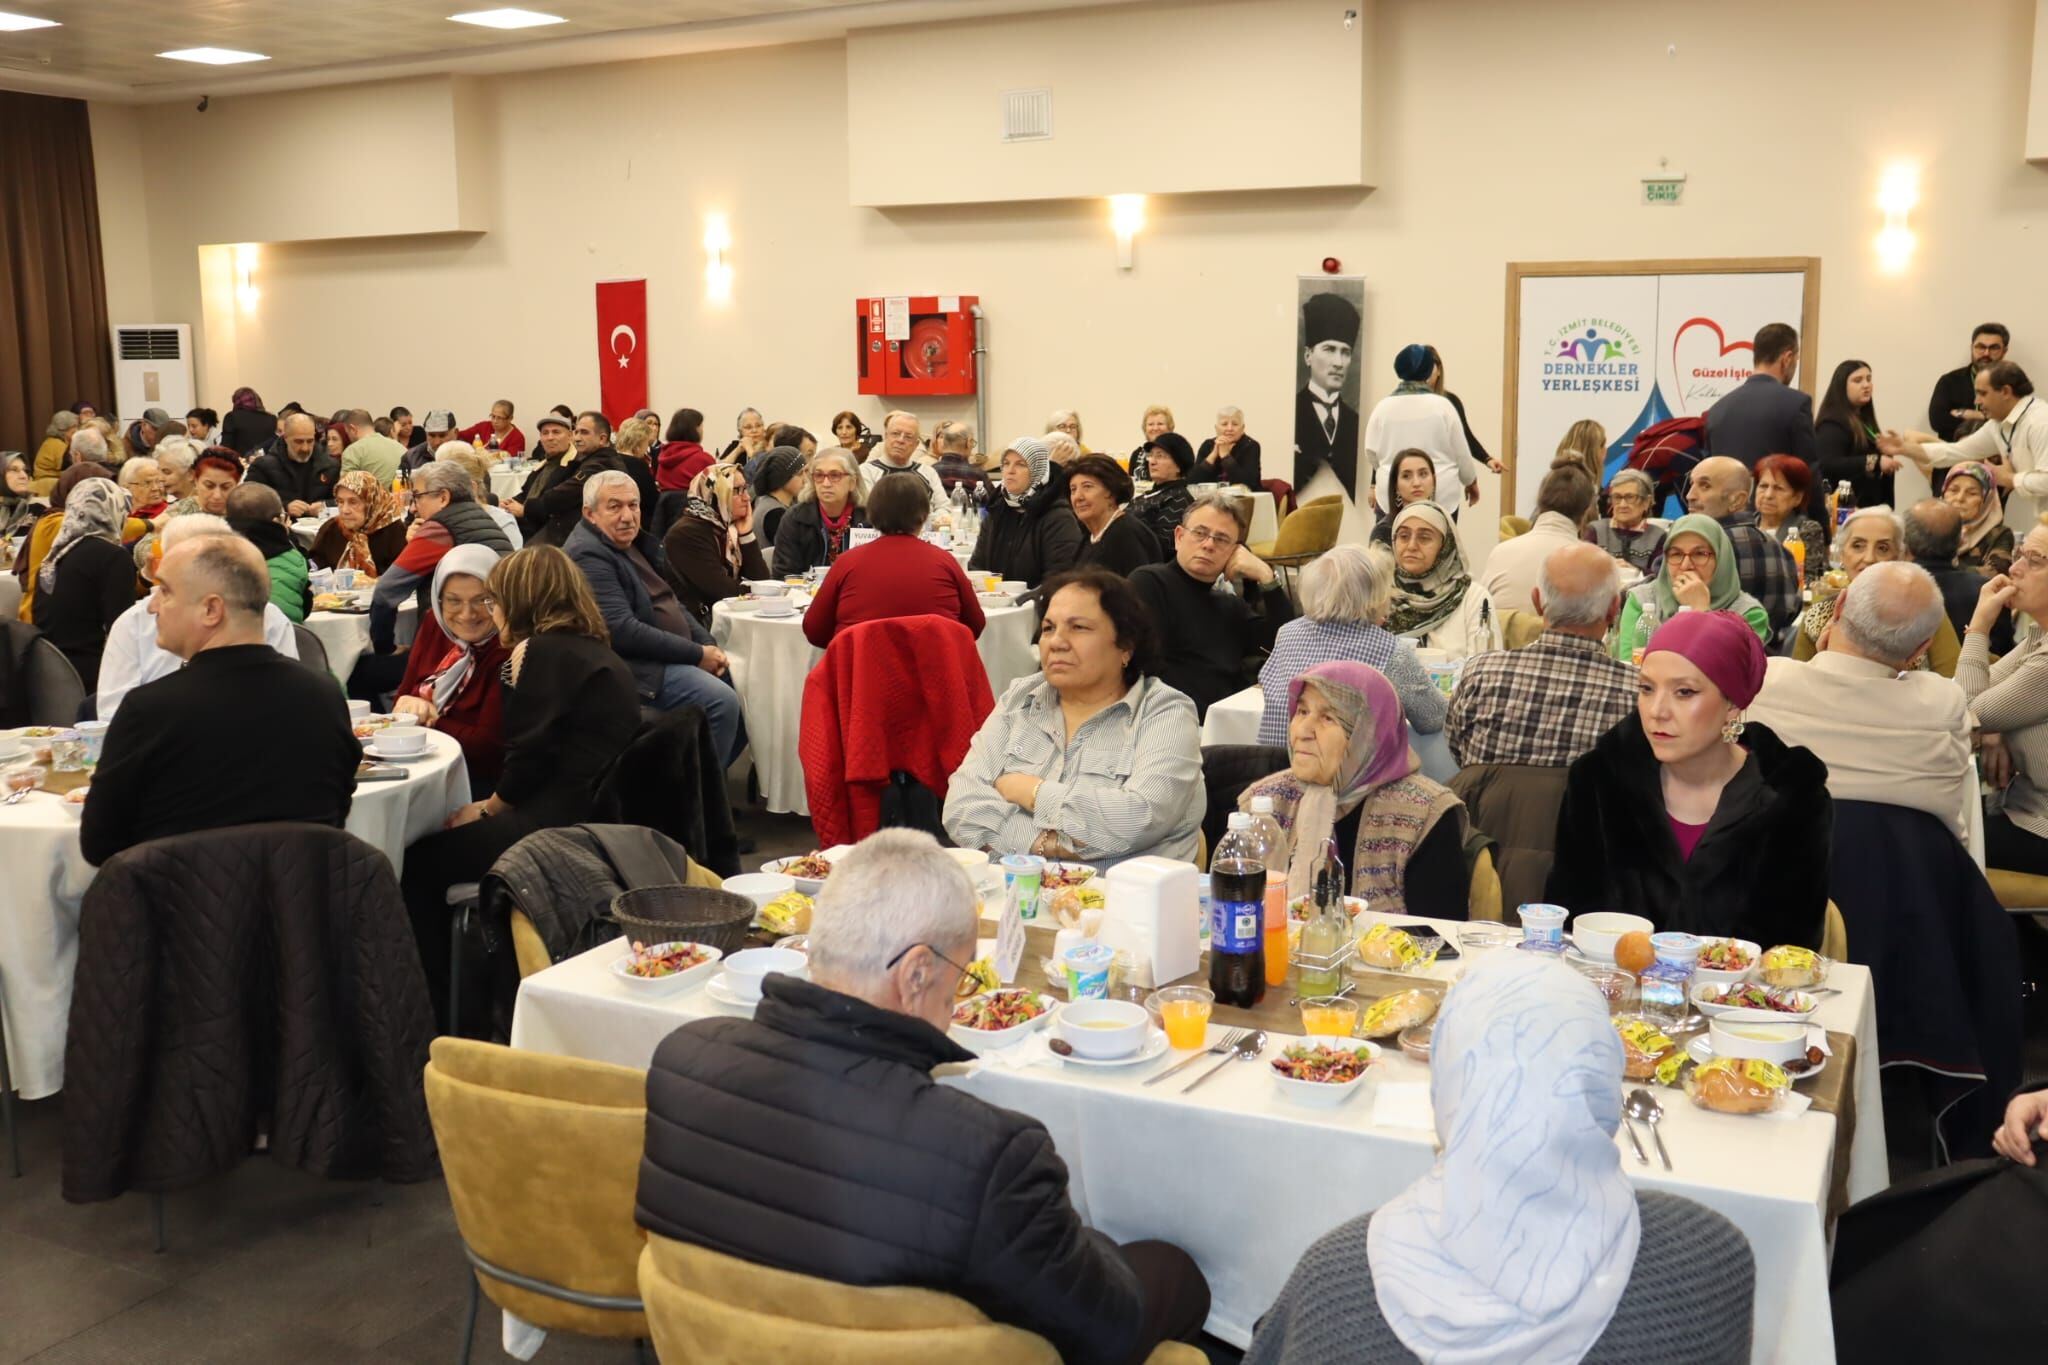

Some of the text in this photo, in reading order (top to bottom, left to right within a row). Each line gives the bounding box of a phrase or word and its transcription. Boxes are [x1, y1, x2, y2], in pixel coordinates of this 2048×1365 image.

[1647, 184, 1677, 192] EXIT
[1559, 318, 1587, 337] İZMİT
[1591, 318, 1641, 356] BELEDİYESİ
[1543, 363, 1638, 375] DERNEKLER
[1692, 366, 1753, 381] Güzel İşle
[1542, 377, 1640, 393] YERLEŞKESİ
